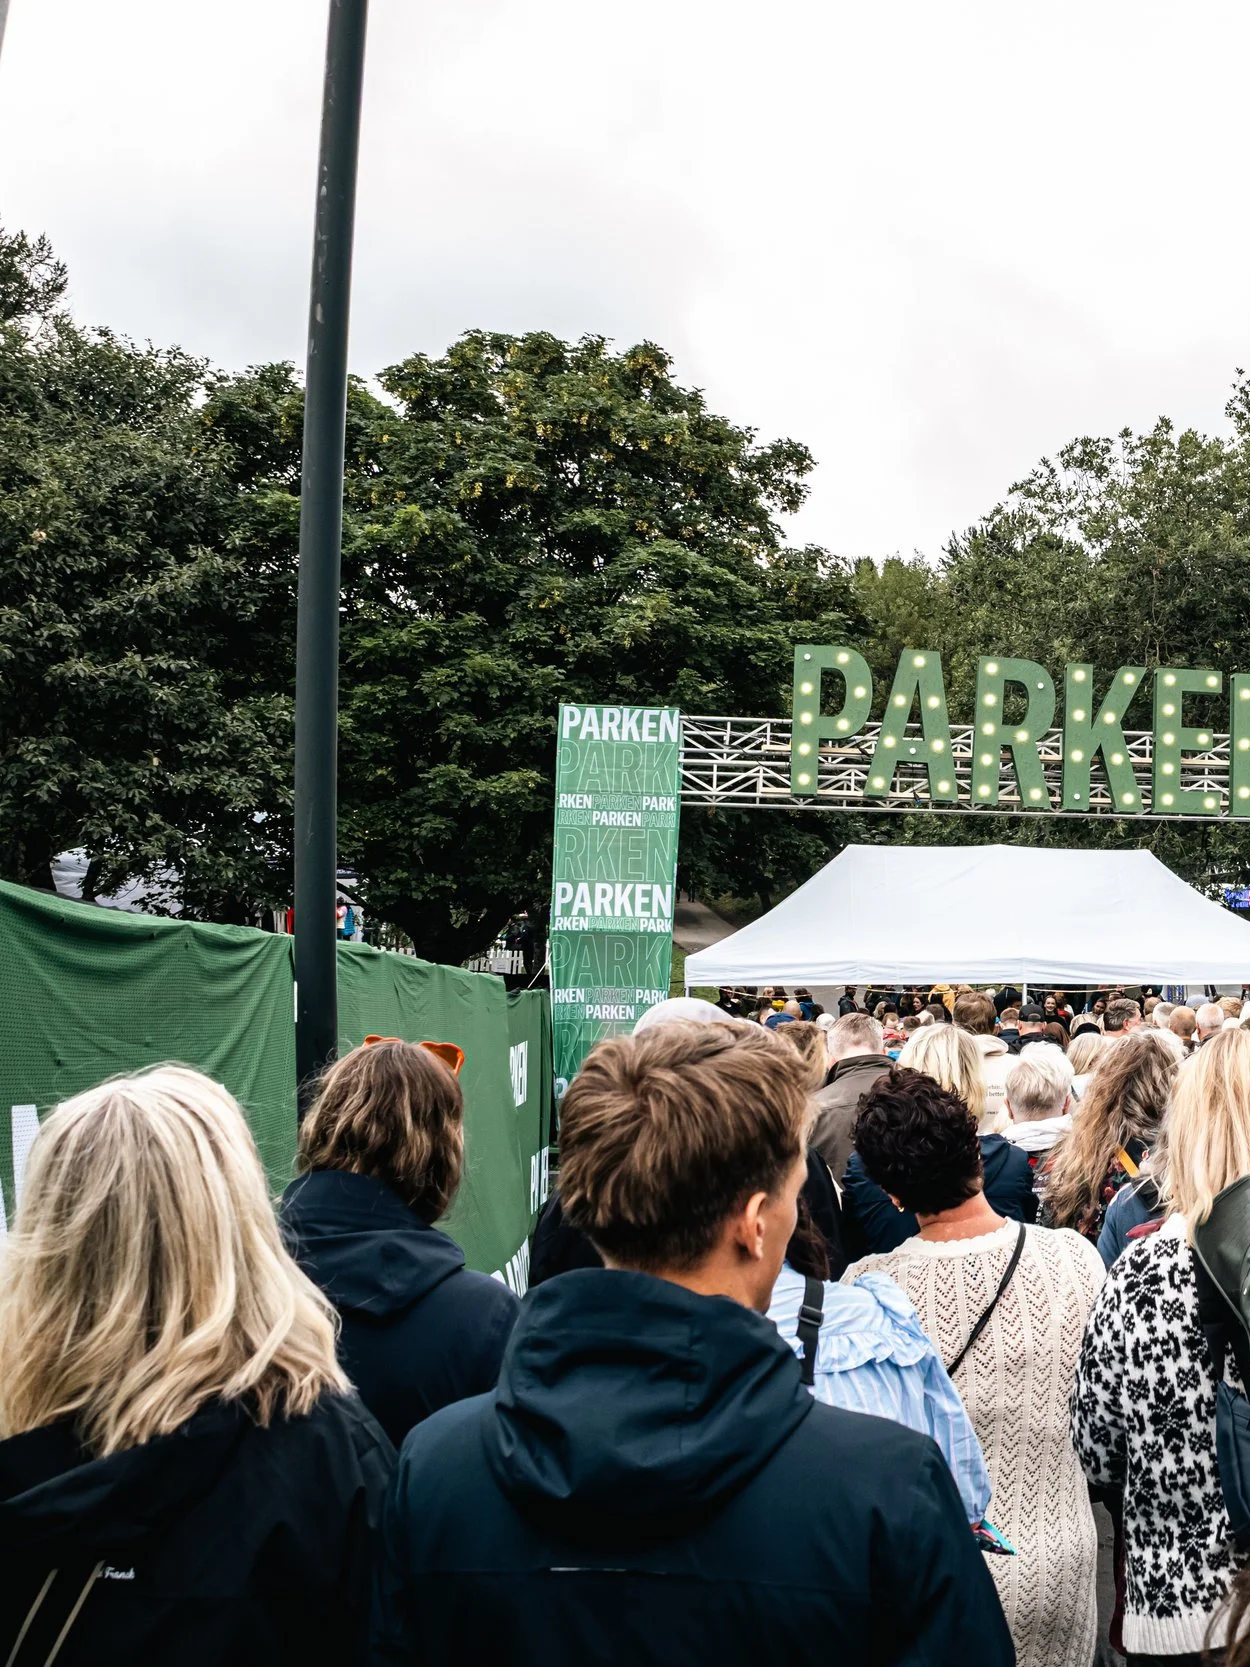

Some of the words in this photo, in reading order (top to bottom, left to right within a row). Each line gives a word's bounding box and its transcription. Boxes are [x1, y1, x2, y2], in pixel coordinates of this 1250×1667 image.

[562, 705, 679, 742] PARKEN
[592, 811, 641, 826] PARKEN
[555, 882, 672, 918] PARKEN
[585, 1005, 635, 1020] PARKEN
